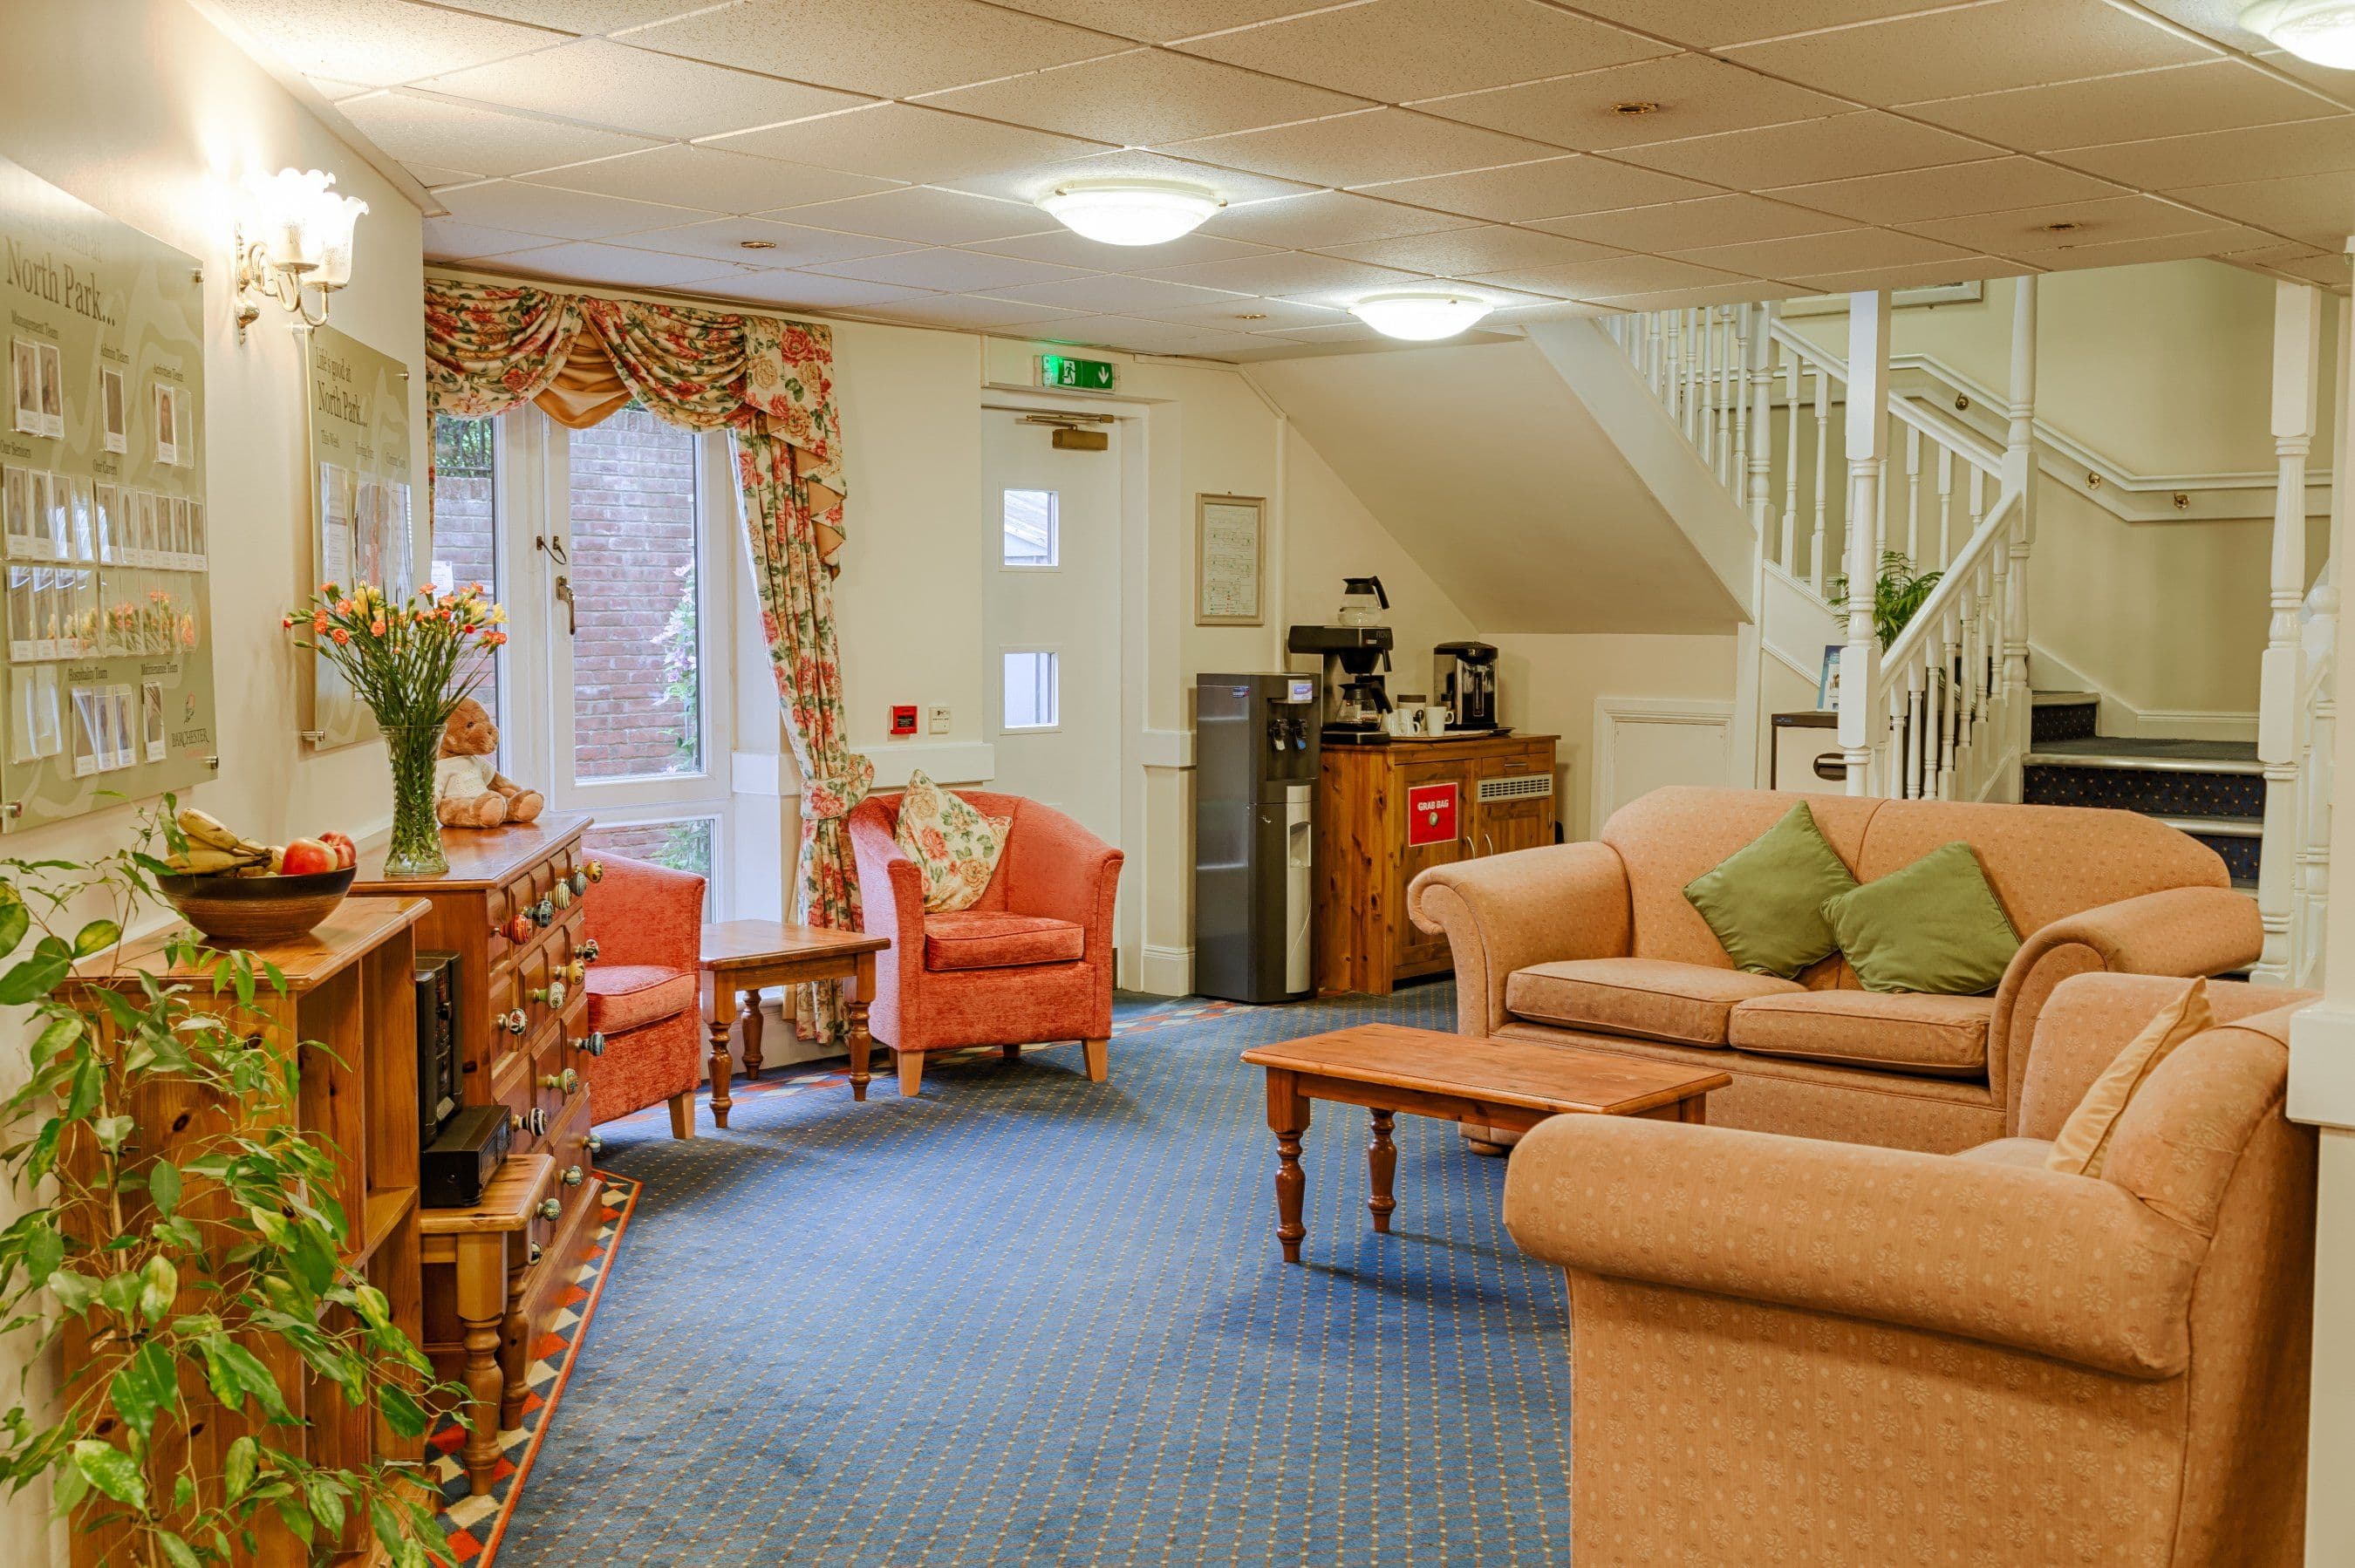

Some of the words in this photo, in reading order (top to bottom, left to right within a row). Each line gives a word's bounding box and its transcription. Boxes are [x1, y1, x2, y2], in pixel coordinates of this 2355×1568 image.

[6, 236, 59, 304] North
[64, 263, 115, 326] Park...
[44, 322, 58, 340] Team
[116, 348, 129, 365] Team
[315, 346, 331, 373] Life's
[331, 358, 345, 382] good
[345, 365, 352, 383] at
[172, 368, 184, 383] Team
[317, 379, 342, 419] North
[343, 392, 368, 428] Park...
[320, 429, 330, 446] This
[0, 439, 11, 454] Our
[11, 441, 31, 459] Seniors
[92, 459, 103, 474] Our
[103, 460, 118, 476] Carers
[69, 668, 94, 684] Hospitality
[95, 666, 108, 679] Team
[167, 662, 178, 674] Team
[171, 728, 210, 748] BARCHESTER
[1417, 801, 1436, 812] GRAB
[1436, 799, 1450, 809] BAG
